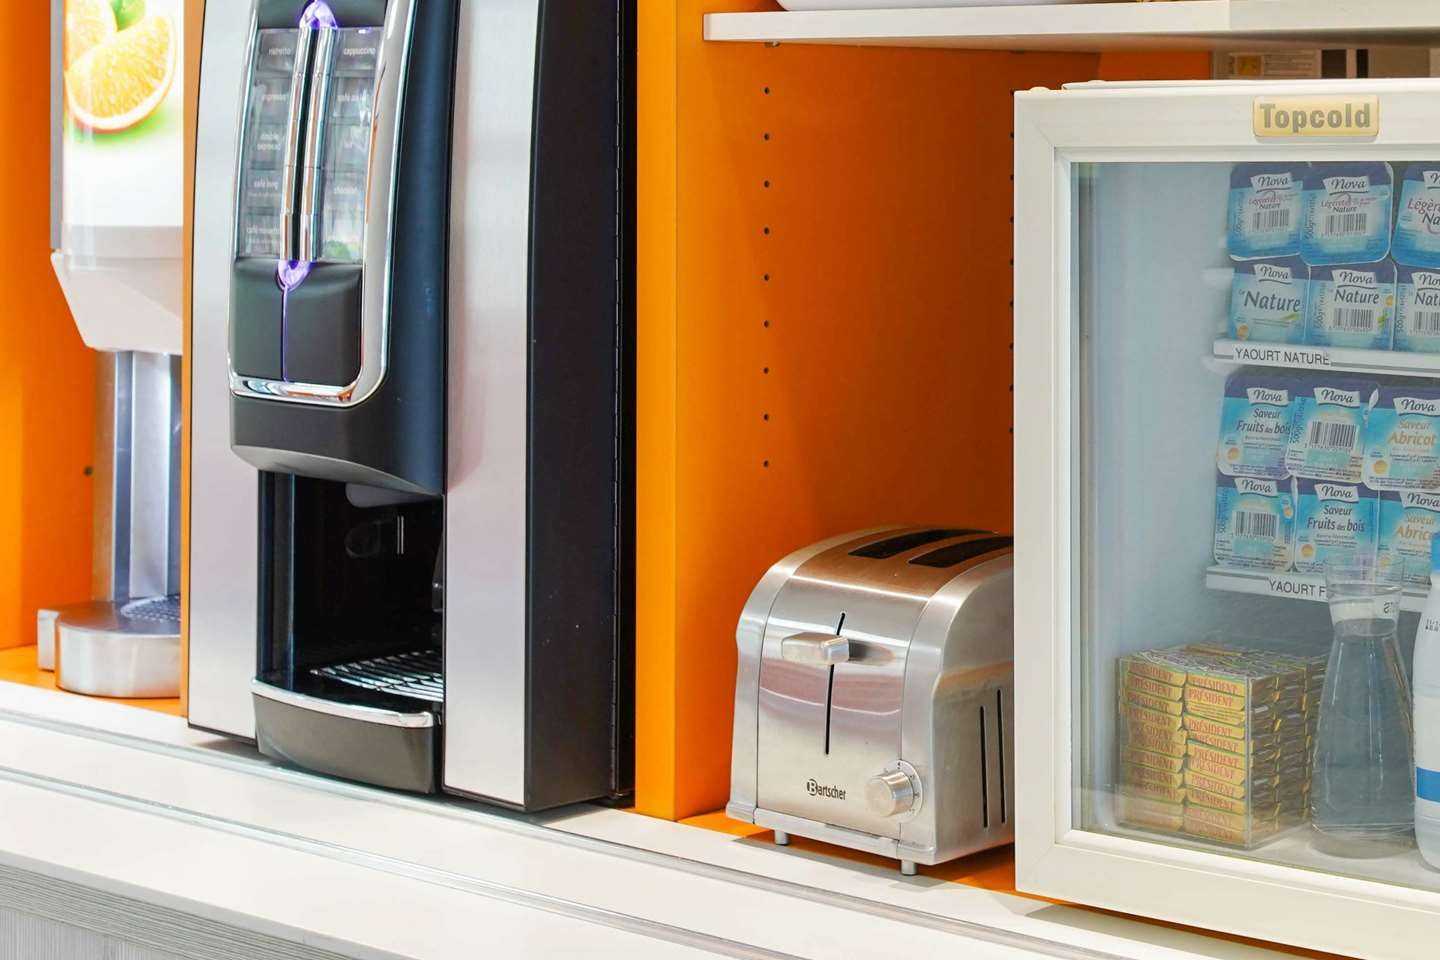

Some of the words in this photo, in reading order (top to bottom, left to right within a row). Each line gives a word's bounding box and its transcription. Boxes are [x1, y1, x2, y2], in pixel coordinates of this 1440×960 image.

[1260, 103, 1371, 133] Topcold
[1257, 174, 1290, 187] Nova
[1330, 177, 1367, 189] Nova
[1260, 265, 1290, 280] Nova
[1339, 270, 1374, 284] Nova
[1243, 291, 1301, 312] Nature
[1333, 289, 1380, 305] Nature
[1235, 347, 1281, 362] YAOURT
[1284, 351, 1331, 365] NATURE
[1253, 389, 1283, 403] Nova
[1321, 389, 1354, 403] Nova
[1400, 398, 1437, 412] Nova
[1236, 420, 1264, 434] Fruits
[1241, 479, 1273, 493] Nova
[1321, 485, 1353, 499] Nova
[1406, 492, 1440, 508] Nova
[1323, 504, 1353, 516] Saveur
[1307, 516, 1335, 531] Fruits
[1346, 519, 1366, 532] bois
[1268, 576, 1317, 596] YAOURT
[806, 778, 846, 800] Bartscher
